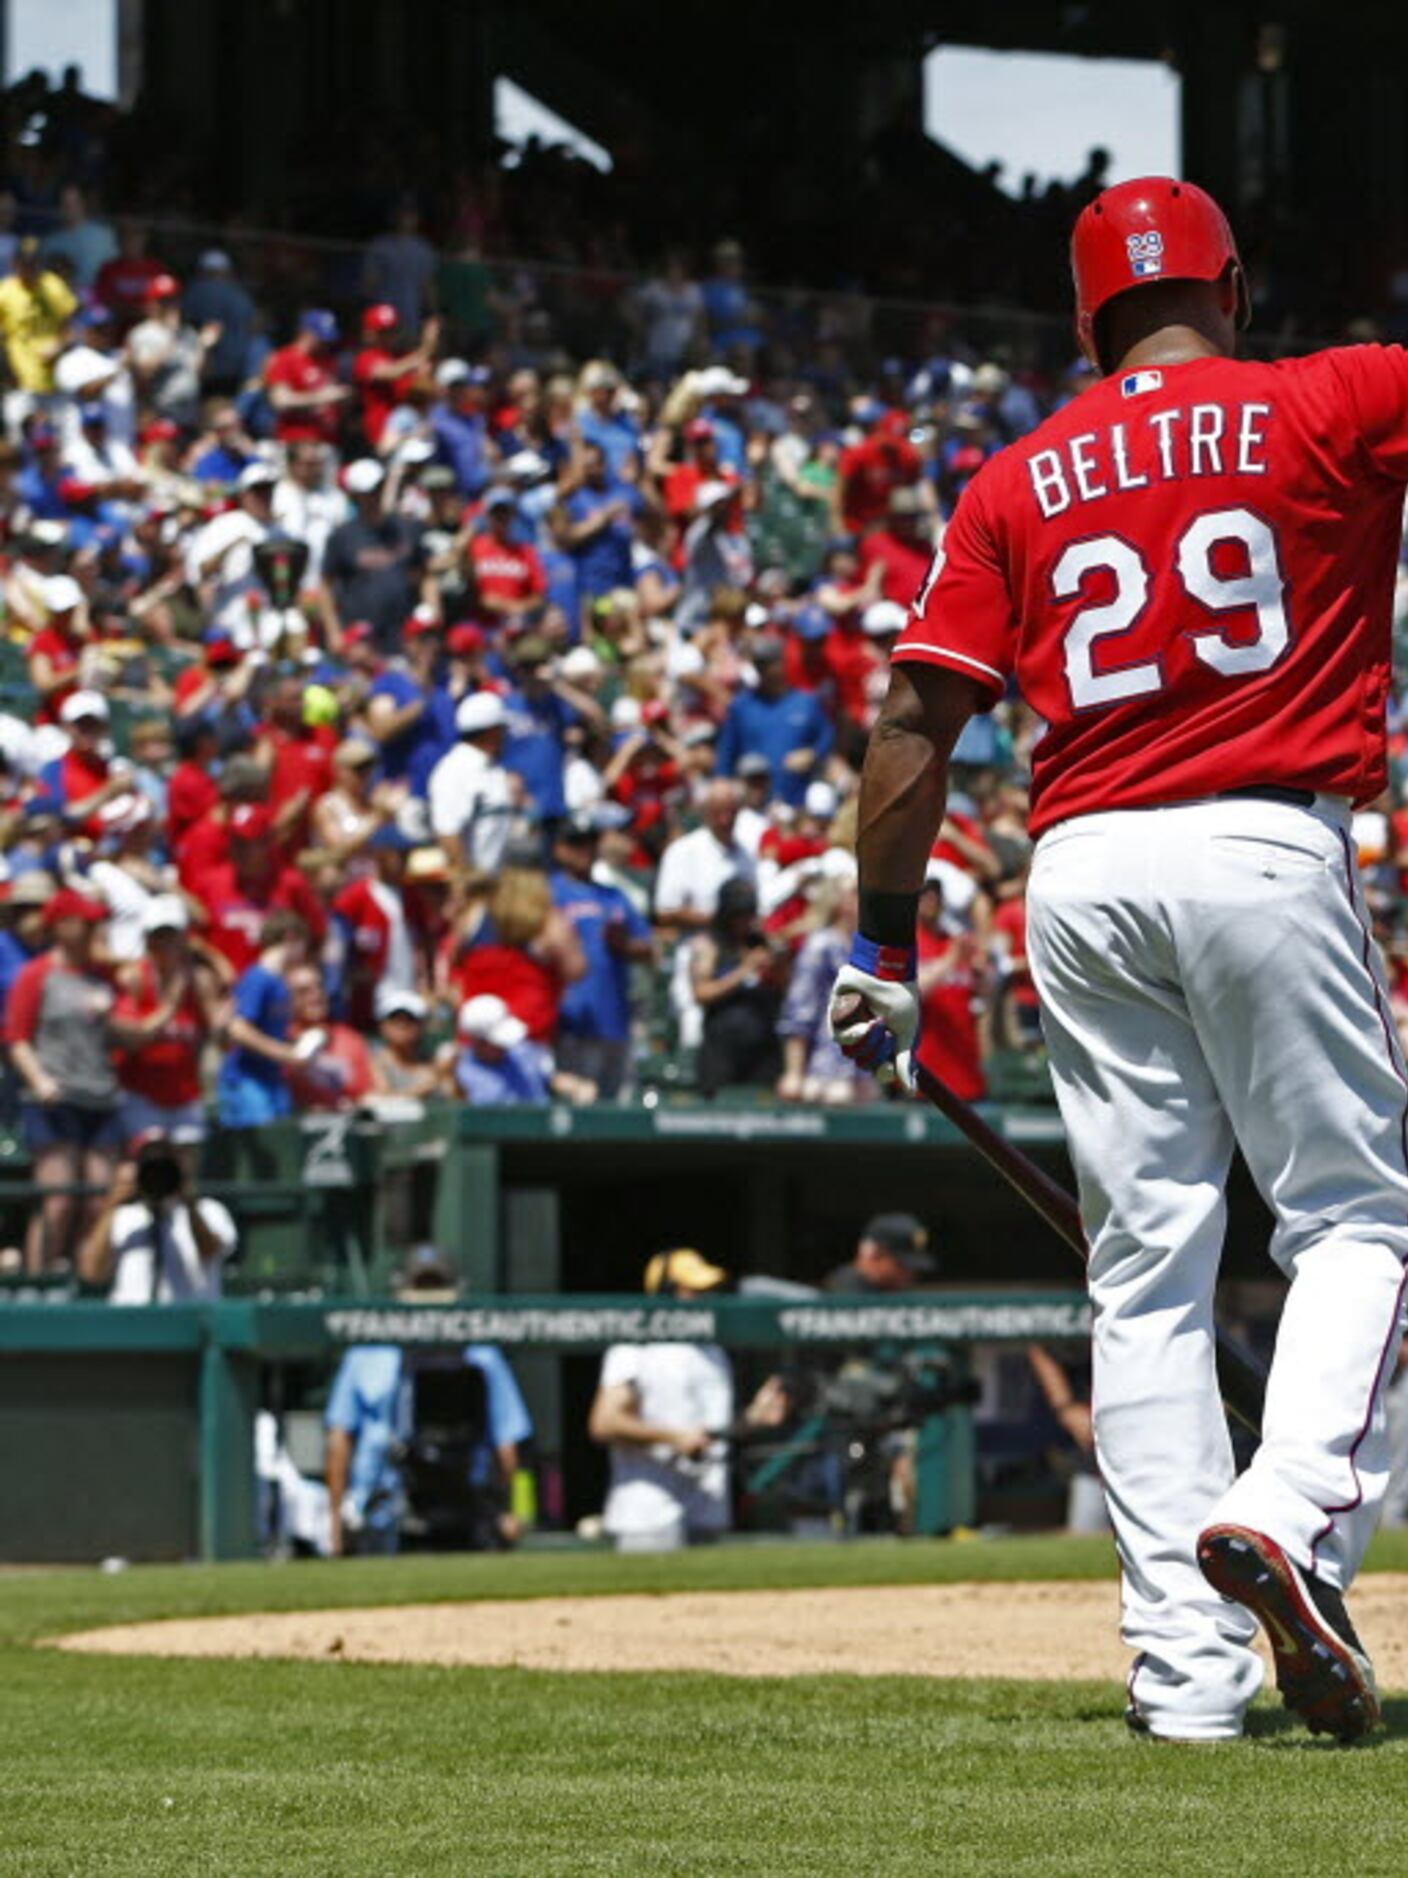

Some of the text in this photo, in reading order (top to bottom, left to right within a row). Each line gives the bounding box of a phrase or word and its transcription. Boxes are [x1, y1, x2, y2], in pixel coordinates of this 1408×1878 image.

[1127, 230, 1164, 262] 29
[1026, 401, 1272, 519] BELTRE
[1050, 505, 1293, 711] 29
